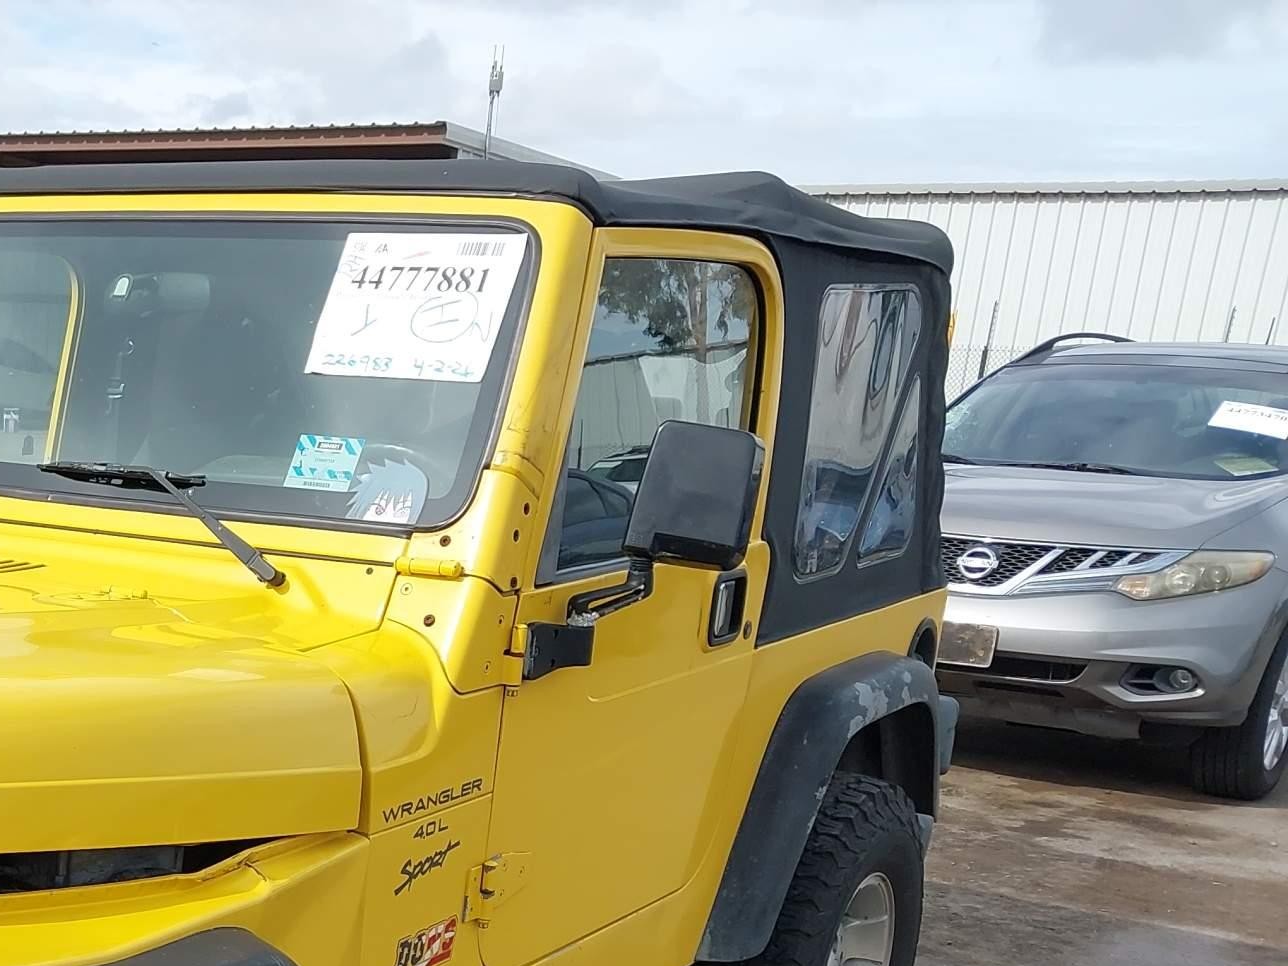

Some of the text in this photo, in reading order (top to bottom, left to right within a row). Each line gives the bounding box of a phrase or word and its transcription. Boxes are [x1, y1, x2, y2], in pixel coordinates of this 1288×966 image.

[351, 265, 490, 293] 44777881
[382, 778, 483, 823] WRANGLER
[394, 840, 461, 896] Sport
